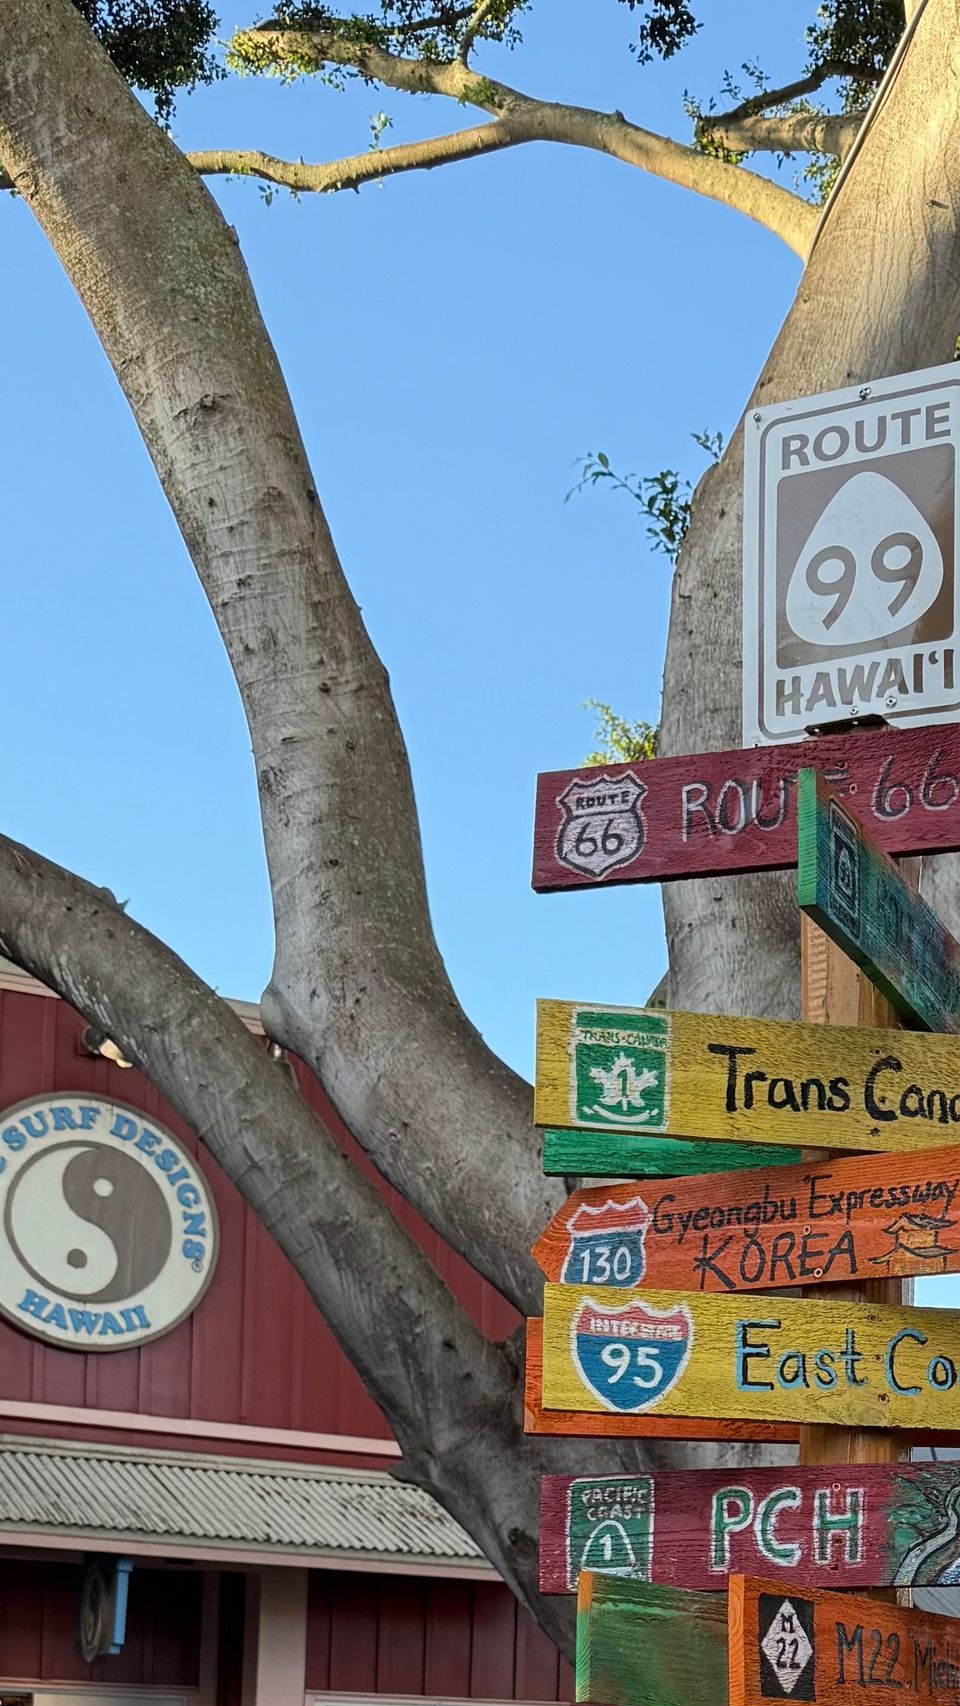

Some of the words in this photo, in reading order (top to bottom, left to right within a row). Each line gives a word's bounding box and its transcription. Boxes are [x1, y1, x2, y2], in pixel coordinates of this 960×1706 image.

[781, 401, 951, 471] ROUTE
[805, 531, 924, 632] 99
[575, 791, 631, 810] ROUTE
[871, 748, 960, 822] 66
[575, 818, 624, 858] 66
[618, 1067, 630, 1101] 1
[707, 1043, 851, 1112] Trans
[2, 1105, 100, 1152] SURF
[652, 1185, 797, 1244] Gyeongbu
[803, 1174, 960, 1225] Expressway
[580, 1247, 632, 1284] 130
[693, 1229, 858, 1291] KOREA
[17, 1288, 151, 1336] HAWAII
[601, 1342, 663, 1388] 95
[736, 1318, 869, 1392] East
[586, 1502, 647, 1522] COAST
[710, 1486, 864, 1573] PCH
[599, 1534, 612, 1561] 1
[780, 1612, 796, 1633] M
[776, 1637, 802, 1669] 22
[835, 1621, 903, 1689] M22
